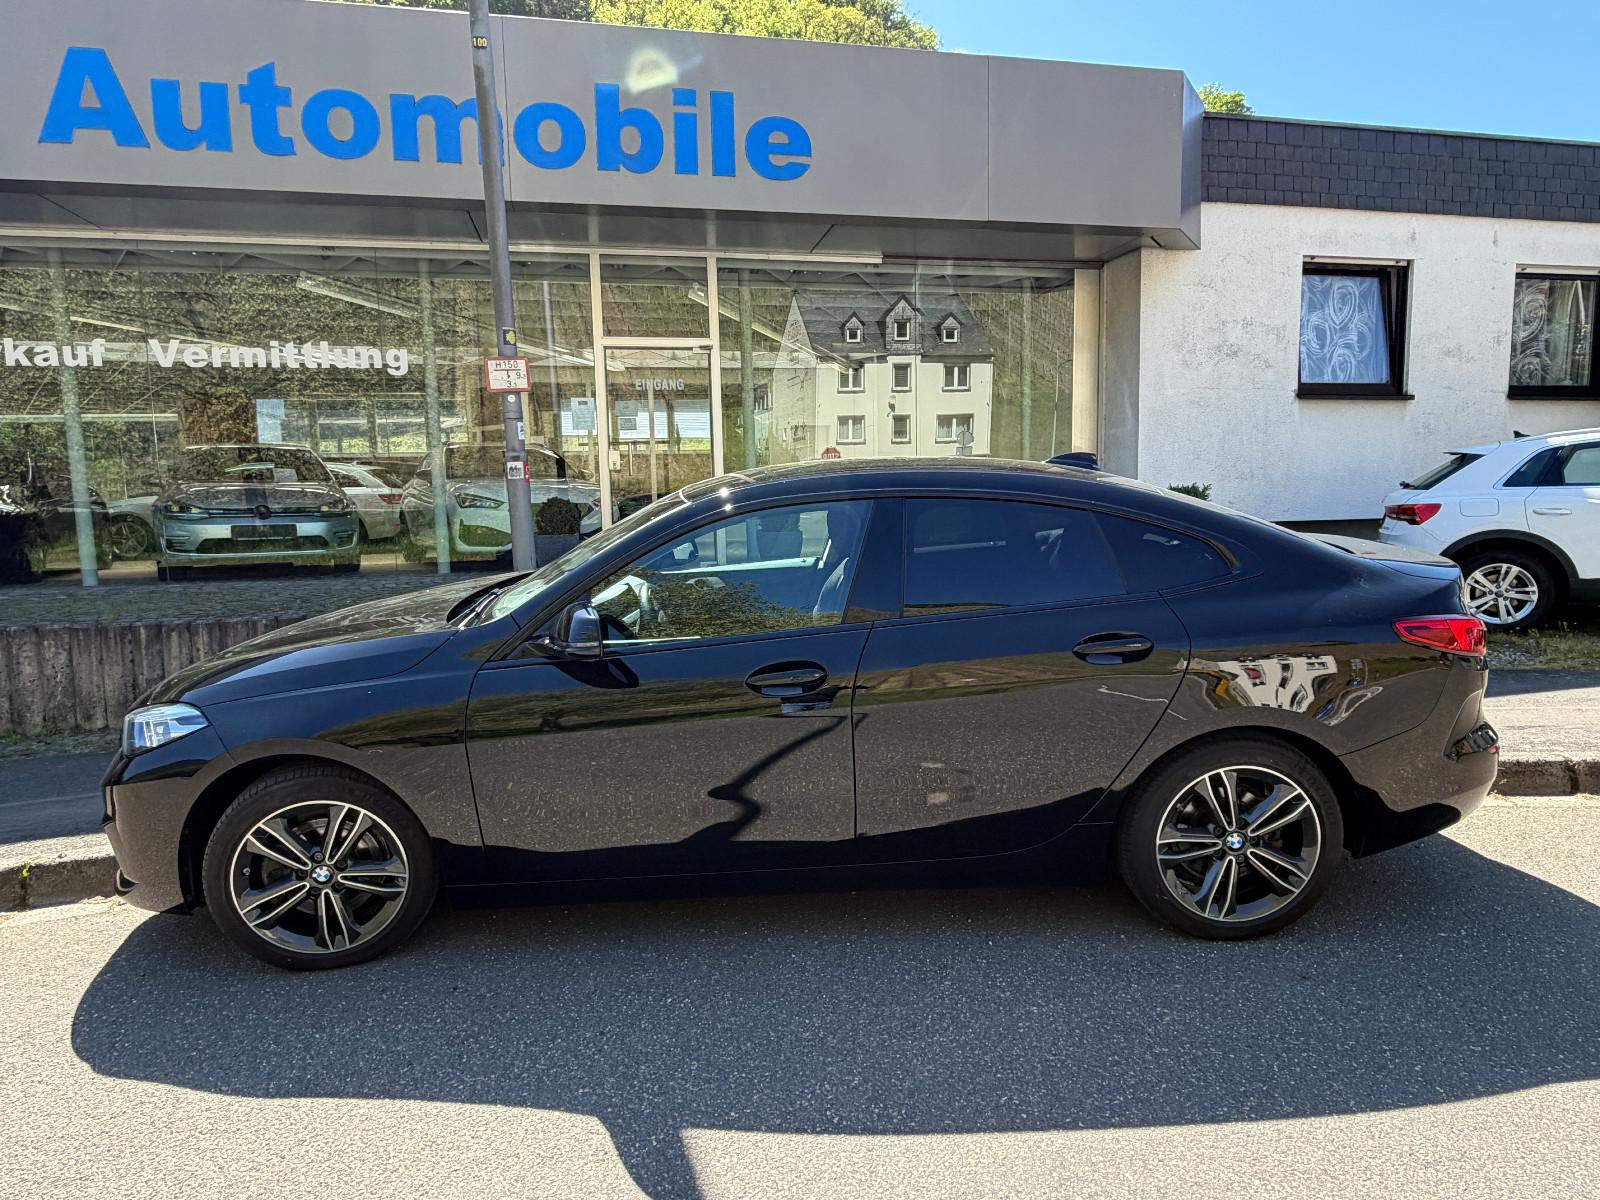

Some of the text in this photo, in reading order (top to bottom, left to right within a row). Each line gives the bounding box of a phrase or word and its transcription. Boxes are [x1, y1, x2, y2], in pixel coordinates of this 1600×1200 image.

[473, 37, 488, 47] 100
[40, 48, 810, 179] Automobile
[0, 337, 410, 376] kauf Vermittlung
[495, 360, 519, 369] H150
[635, 378, 685, 391] EINGANG
